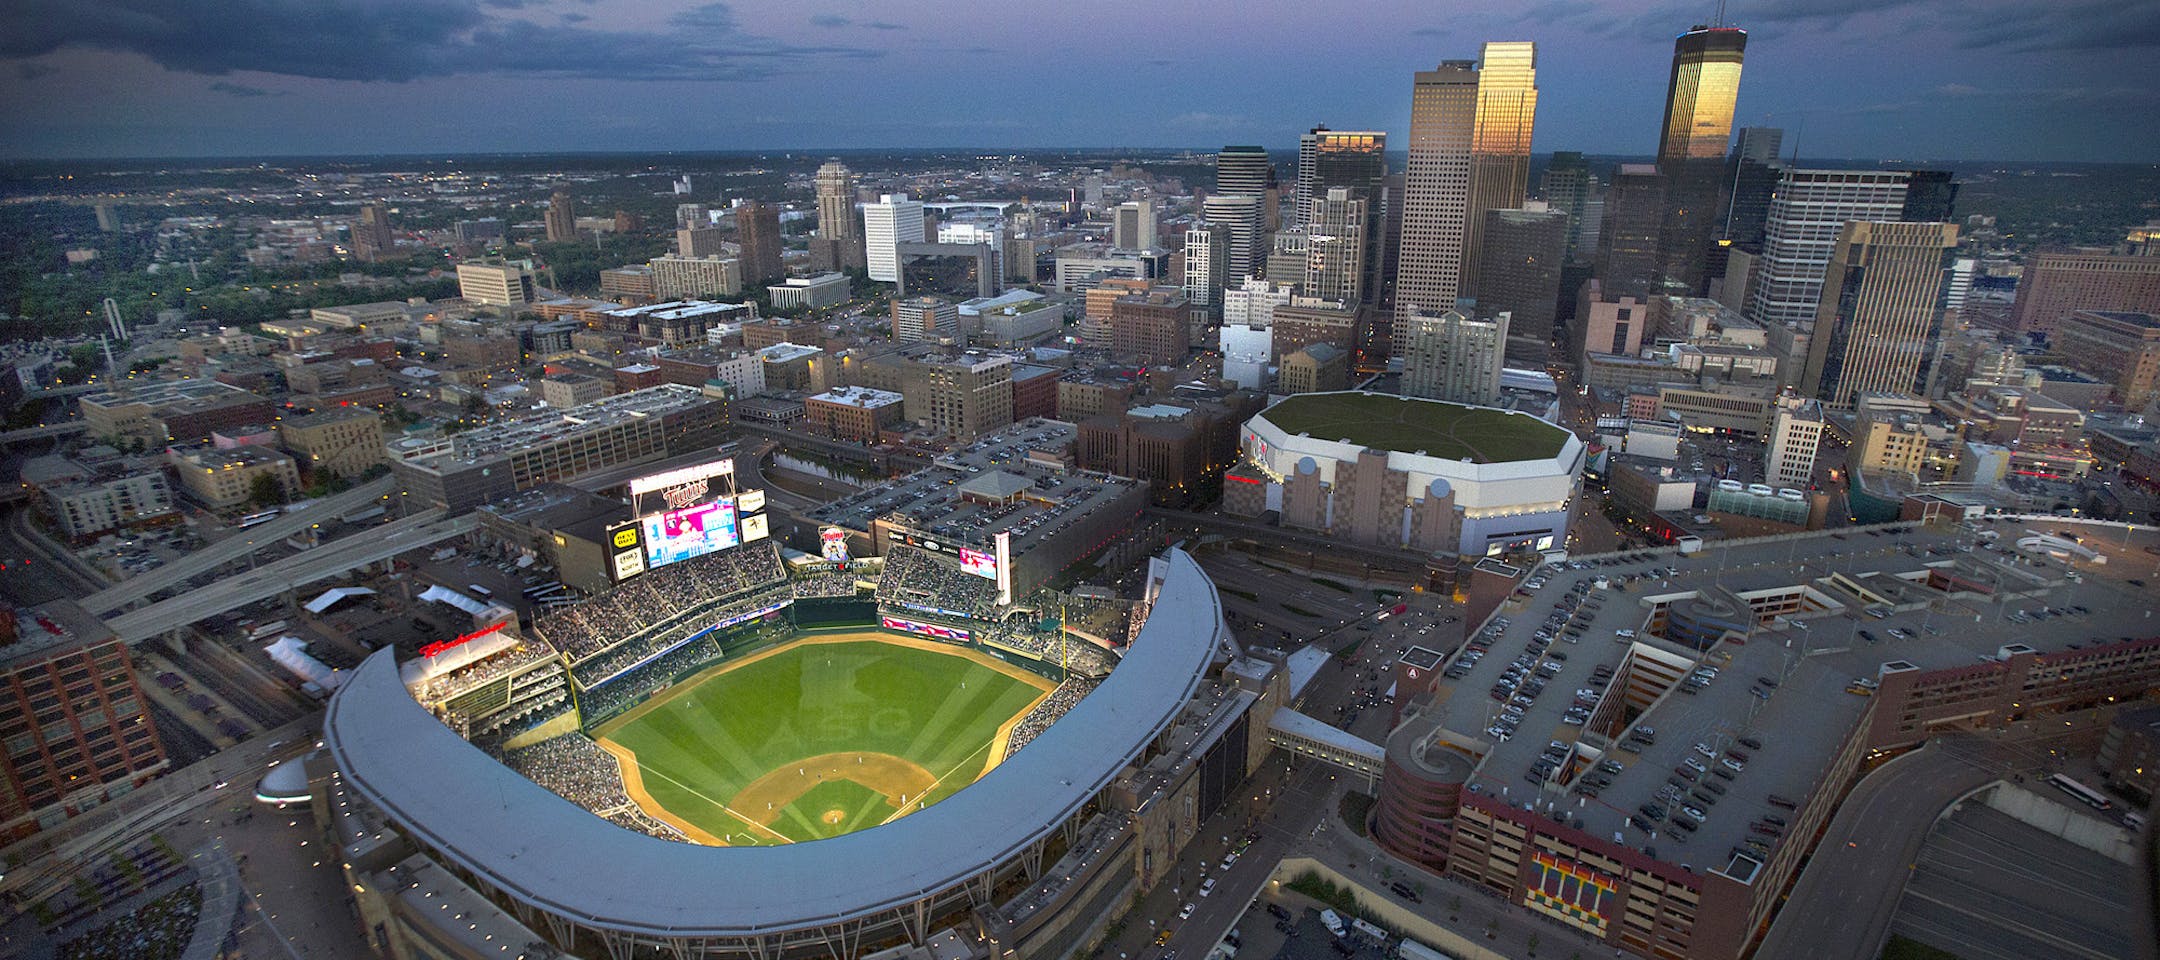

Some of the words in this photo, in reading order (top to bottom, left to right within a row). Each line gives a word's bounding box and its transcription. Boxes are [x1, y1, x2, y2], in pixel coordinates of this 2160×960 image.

[663, 481, 709, 509] Twins
[822, 531, 845, 542] Twins
[806, 563, 837, 571] TARGET
[845, 562, 868, 570] FIELD
